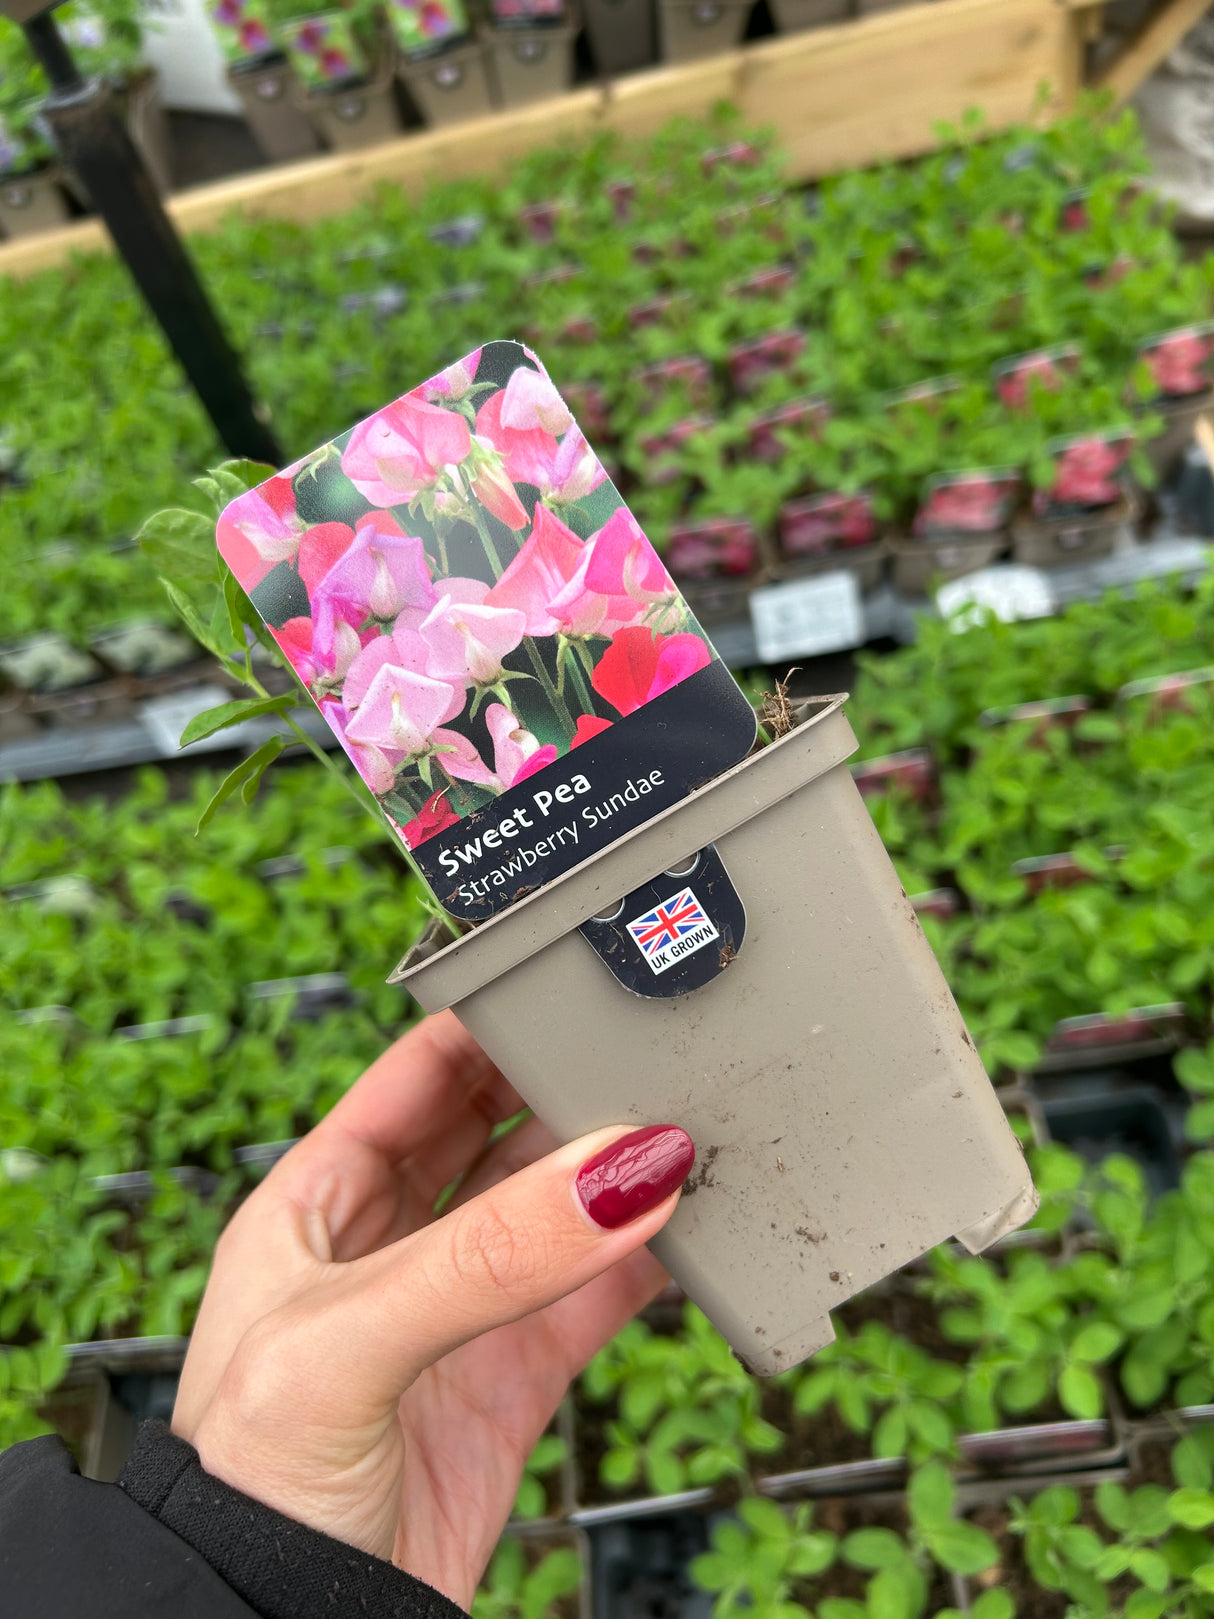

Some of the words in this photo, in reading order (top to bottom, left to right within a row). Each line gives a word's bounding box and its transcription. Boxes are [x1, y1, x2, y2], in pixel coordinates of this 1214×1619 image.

[438, 807, 533, 877] Sweet
[533, 774, 592, 817] Pea
[459, 821, 580, 906] Strawberry
[582, 769, 665, 829] Sundae
[651, 952, 670, 969] UK
[670, 925, 713, 957] GROWN
